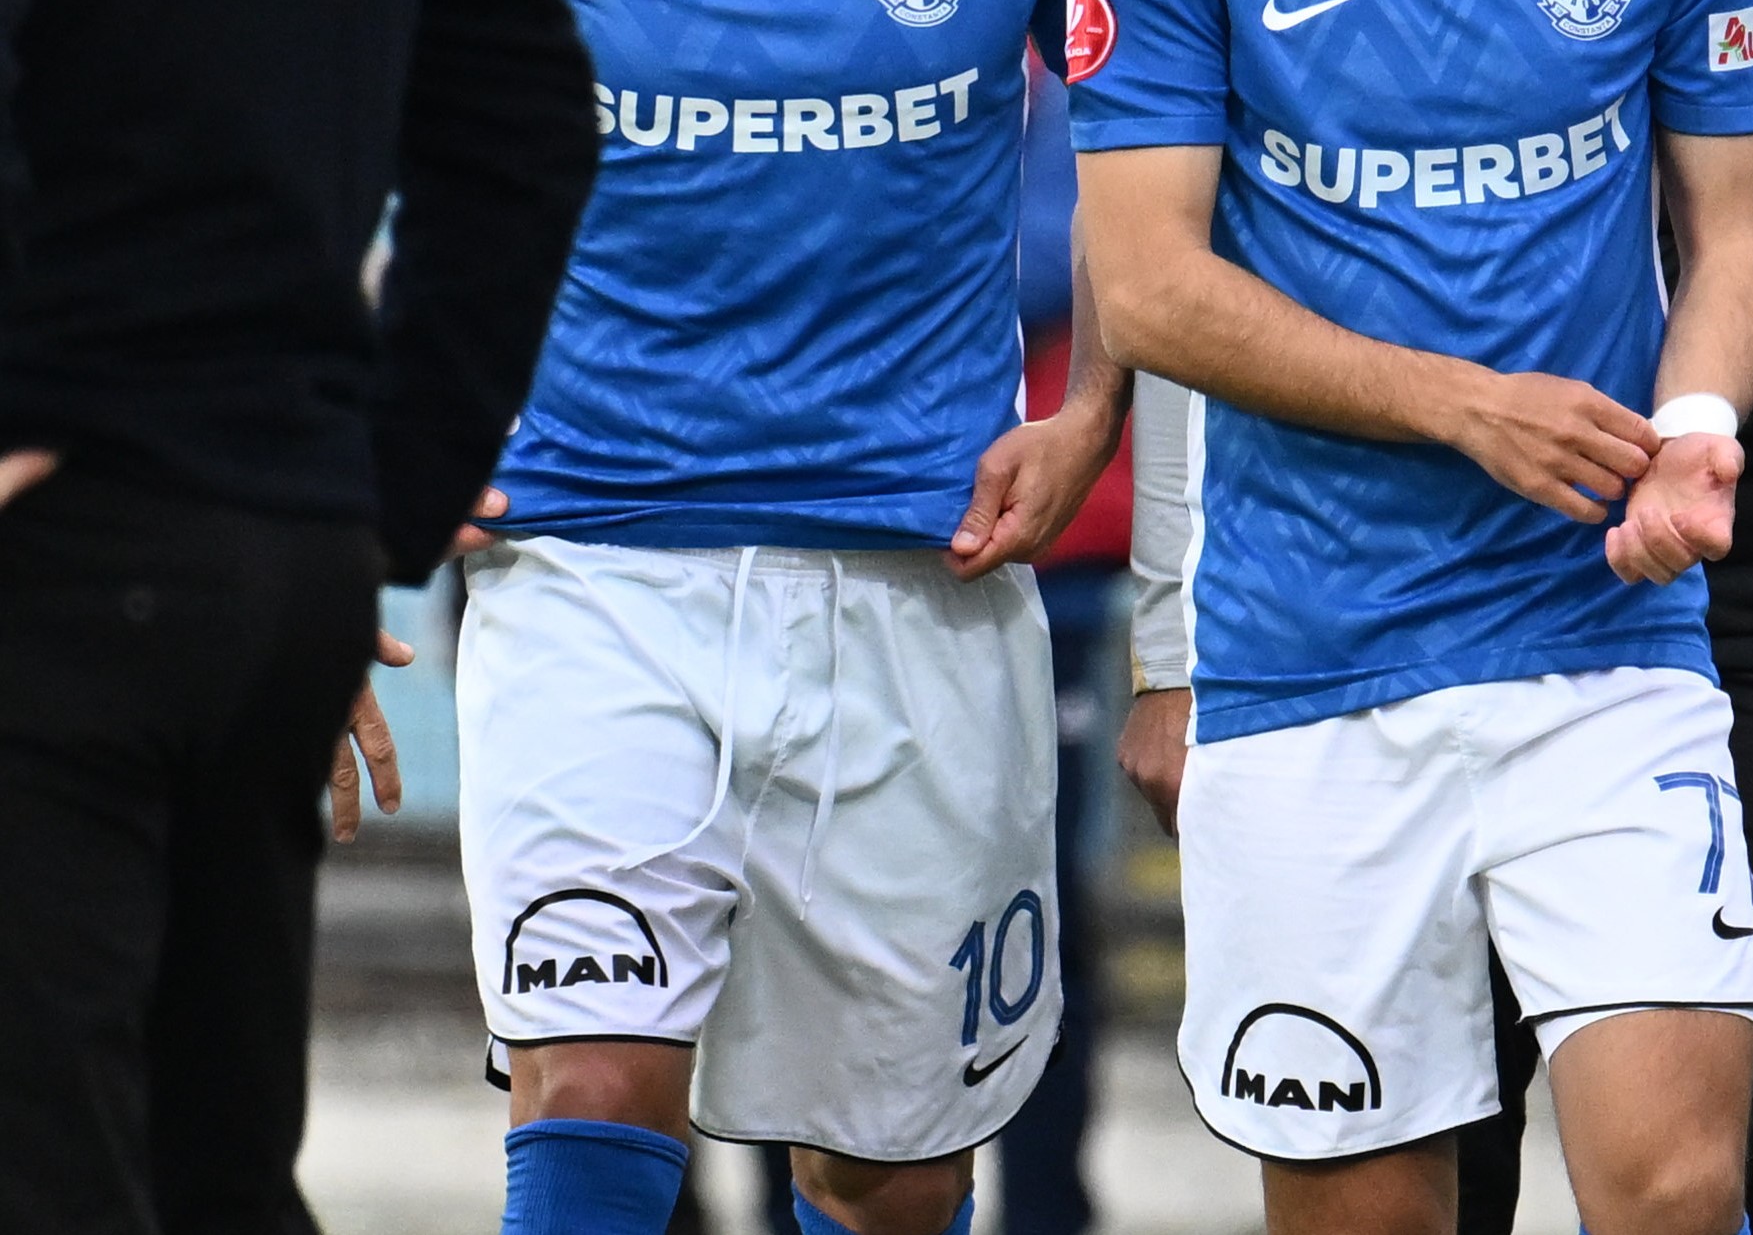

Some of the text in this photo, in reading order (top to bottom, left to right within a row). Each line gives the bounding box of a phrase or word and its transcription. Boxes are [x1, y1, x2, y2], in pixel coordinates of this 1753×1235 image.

[593, 67, 980, 154] SUPERBET
[1260, 92, 1632, 208] SUPERBET
[517, 954, 655, 991] MAN
[949, 889, 1044, 1047] 10
[1235, 1068, 1366, 1113] MAN
